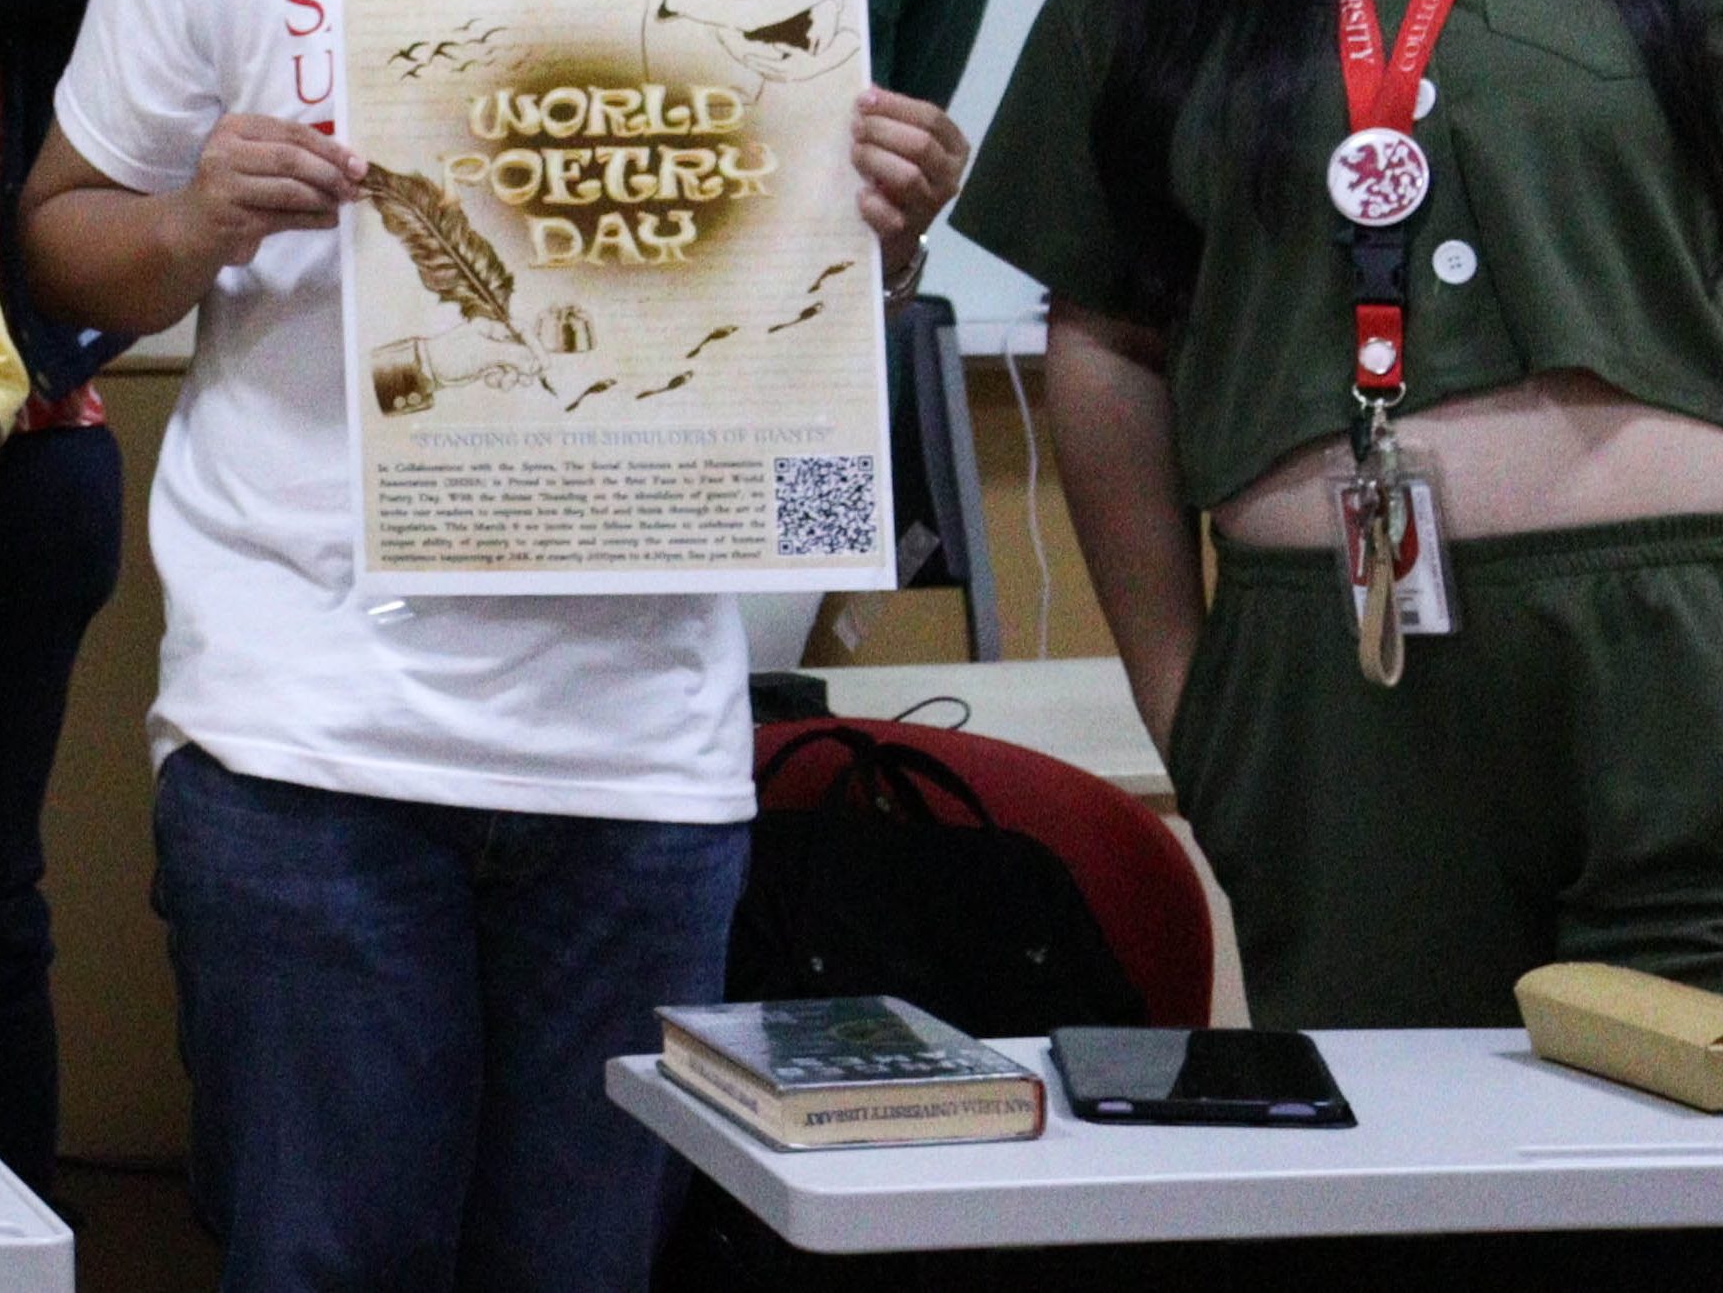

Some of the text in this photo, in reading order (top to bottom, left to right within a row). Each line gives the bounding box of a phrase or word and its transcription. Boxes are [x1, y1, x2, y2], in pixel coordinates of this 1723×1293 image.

[469, 83, 746, 140] WORLD
[441, 143, 777, 205] POETRY
[527, 210, 697, 268] DAY
